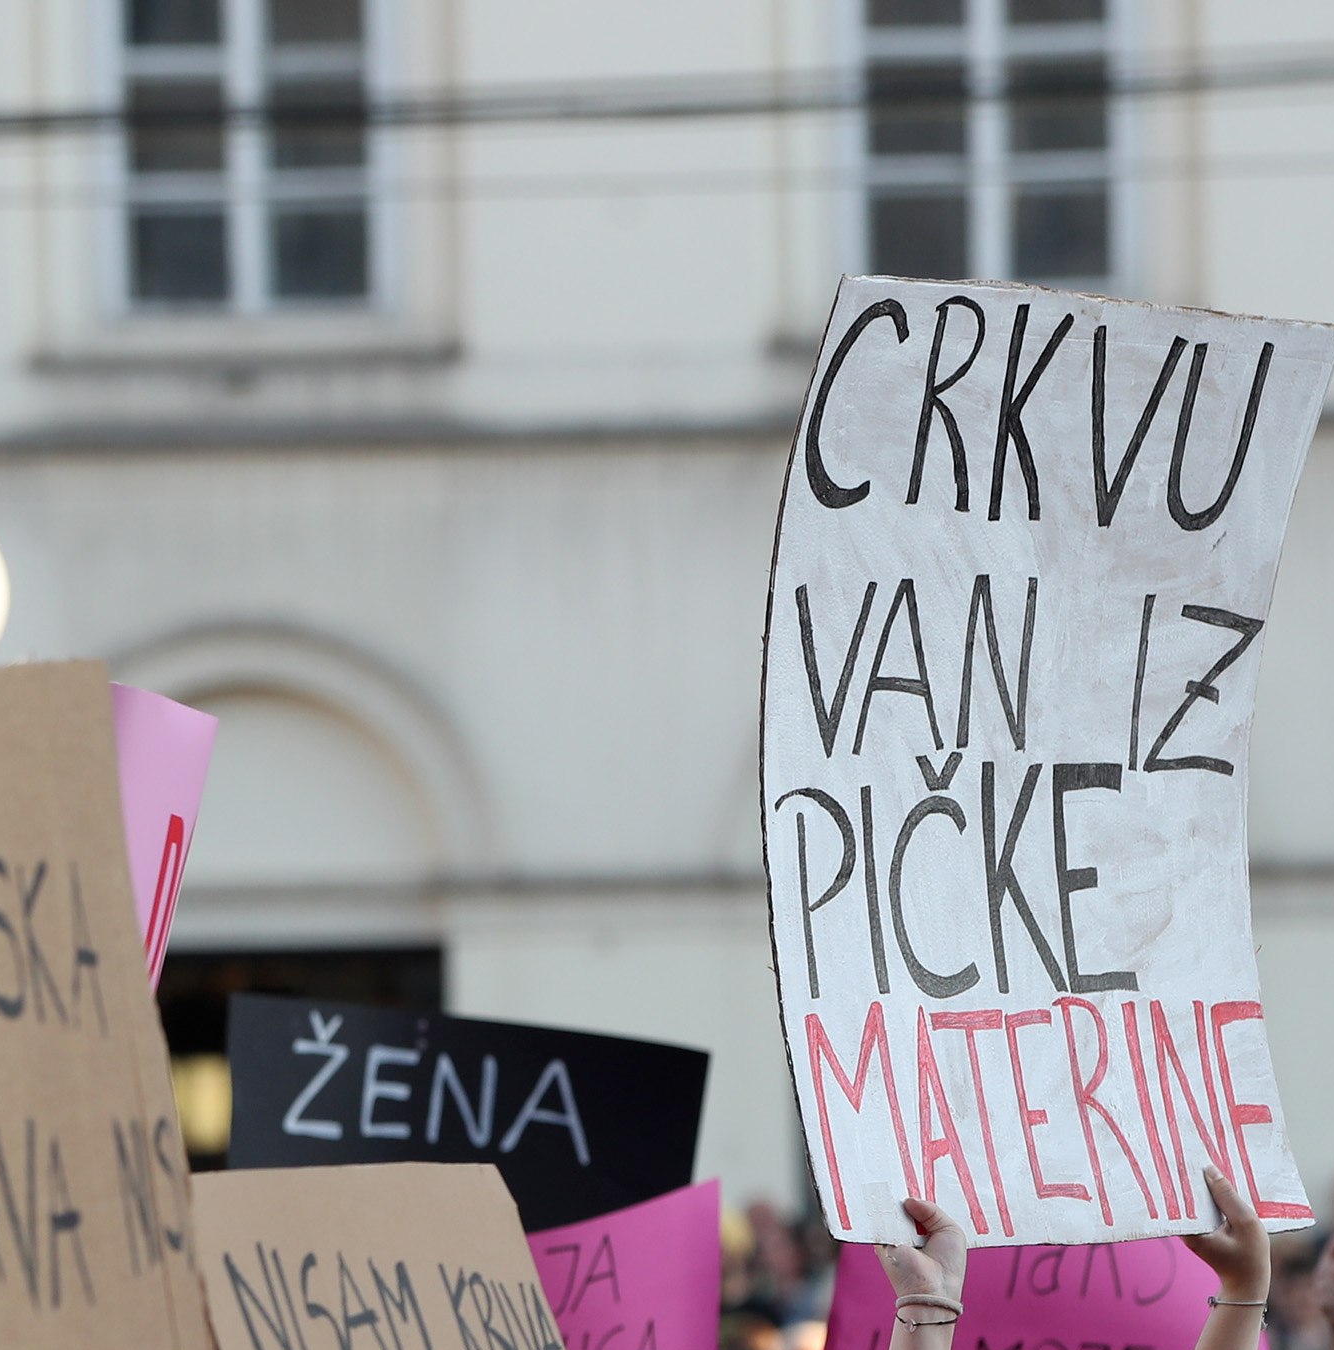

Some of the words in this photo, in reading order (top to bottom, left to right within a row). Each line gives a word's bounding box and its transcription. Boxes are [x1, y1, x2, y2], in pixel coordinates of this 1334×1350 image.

[805, 296, 1274, 532] CRKVU
[795, 574, 1038, 758] VAN
[1128, 594, 1265, 776] IZ
[775, 752, 1140, 998] PIČKE
[282, 1009, 592, 1166] ŽENA
[805, 995, 1315, 1237] MATERINE
